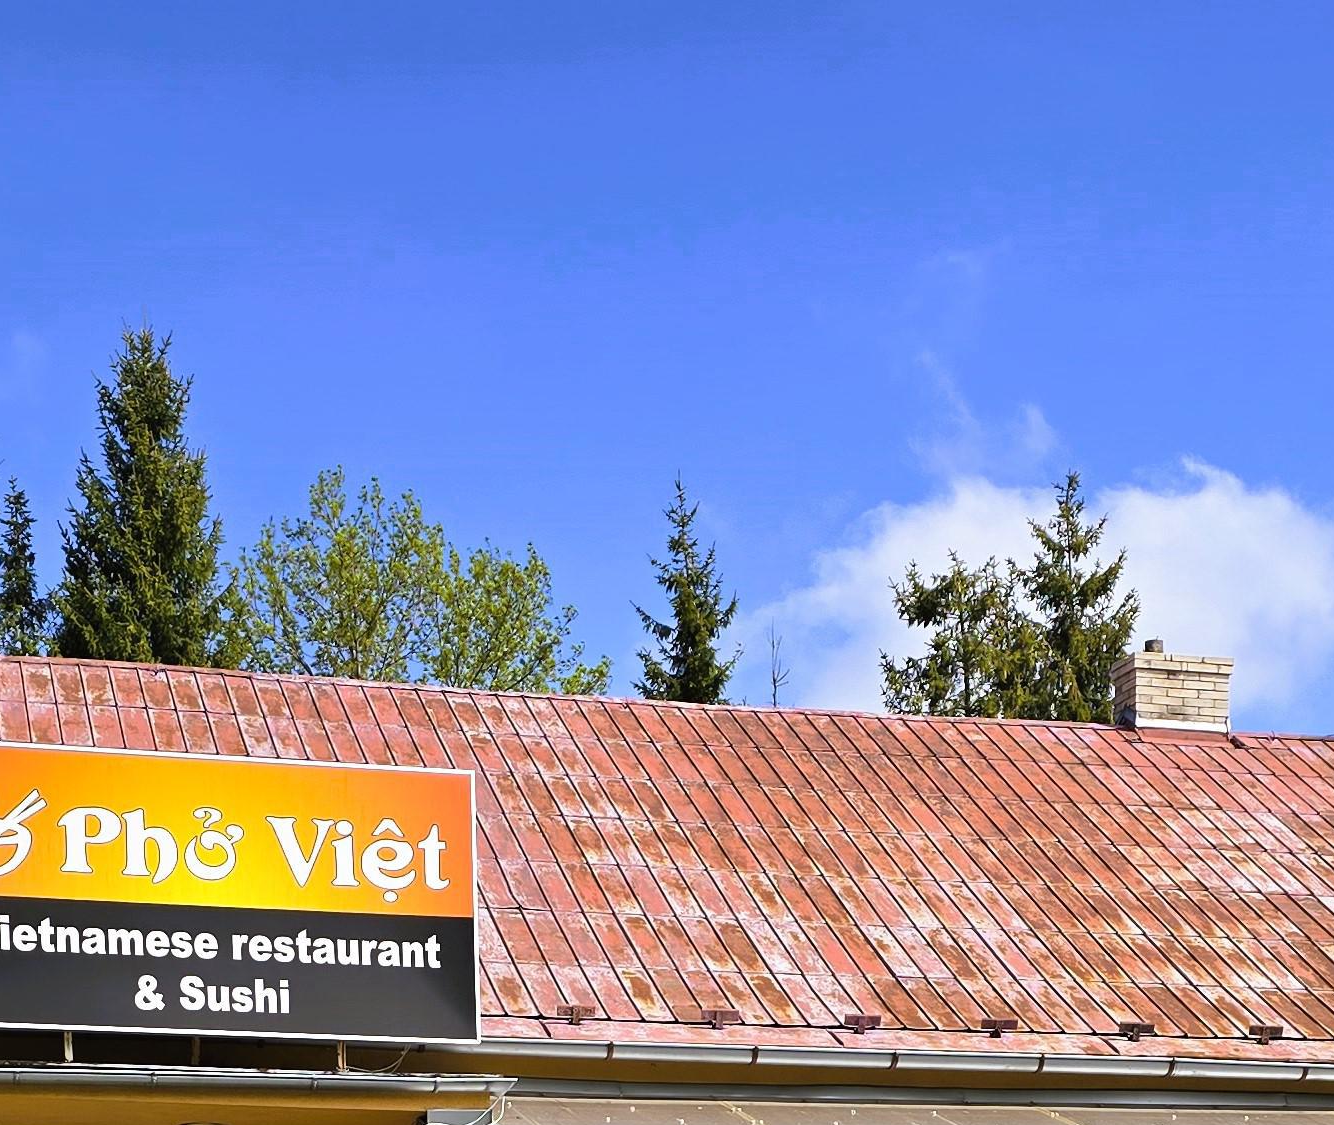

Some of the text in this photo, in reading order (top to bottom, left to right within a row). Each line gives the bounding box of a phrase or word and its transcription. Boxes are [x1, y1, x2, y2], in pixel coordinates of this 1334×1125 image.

[58, 806, 451, 903] Phở Việt
[231, 928, 442, 969] restaurant
[133, 974, 291, 1014] & Sushi
